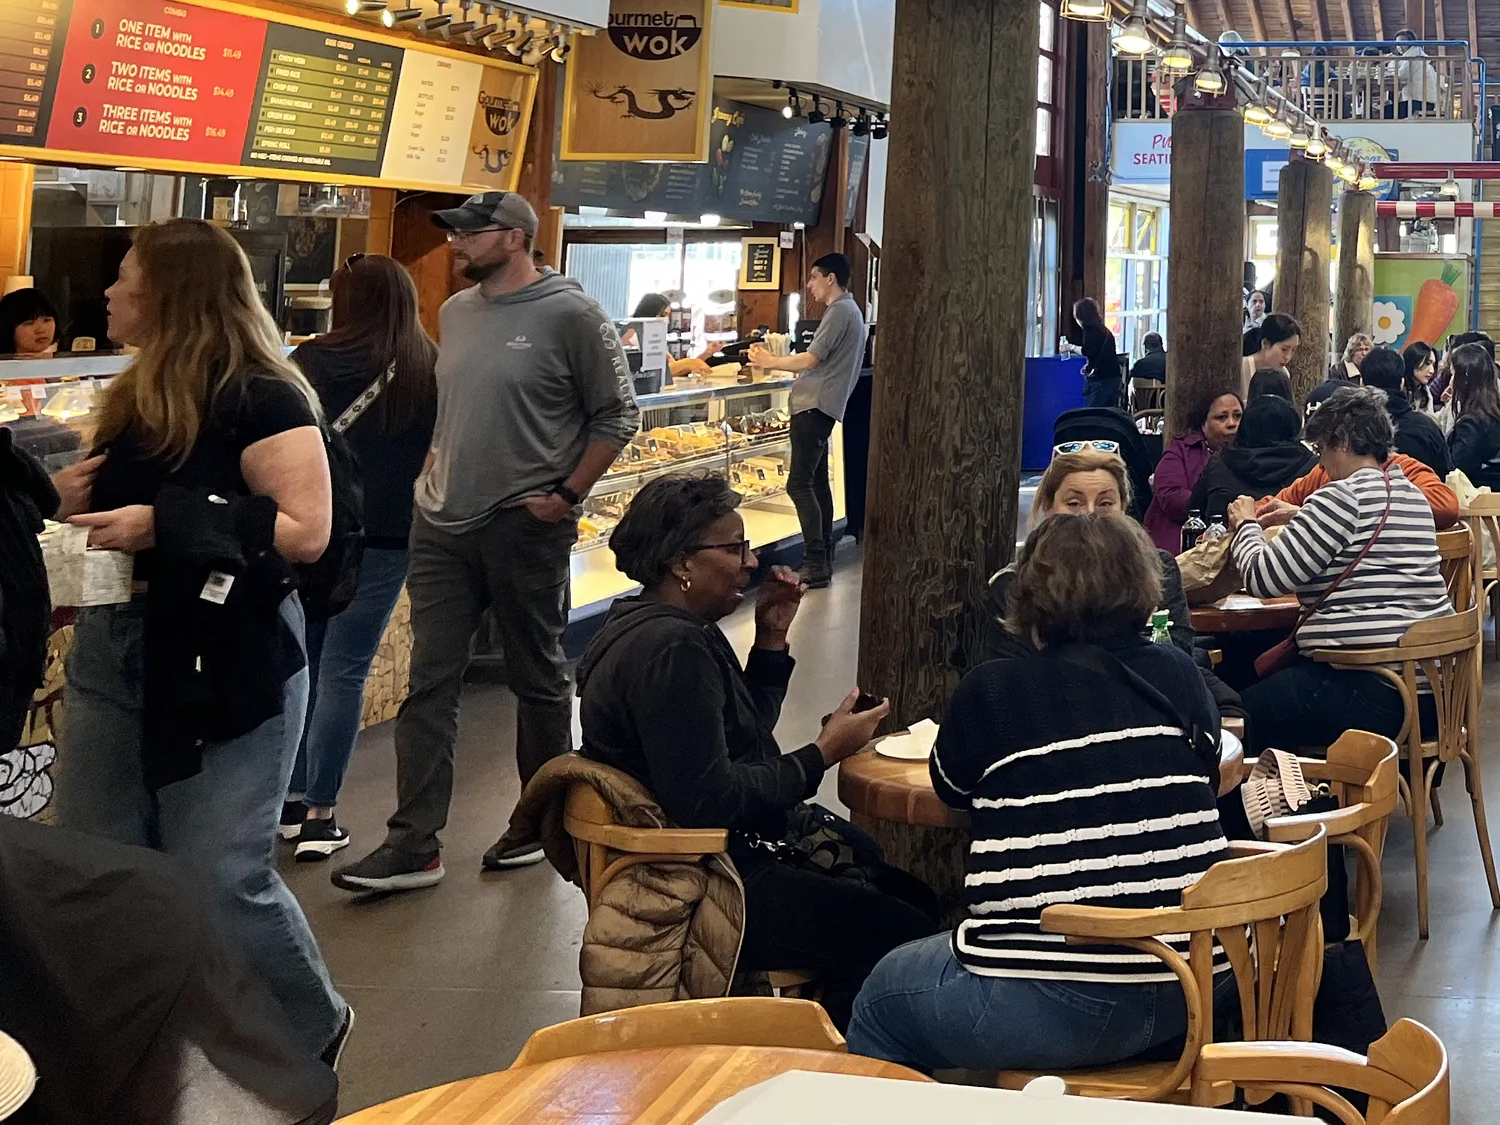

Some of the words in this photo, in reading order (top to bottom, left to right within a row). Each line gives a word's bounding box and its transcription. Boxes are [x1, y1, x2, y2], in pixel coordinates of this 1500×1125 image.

[608, 11, 674, 26] ourmet
[119, 19, 144, 35] ONE
[144, 23, 172, 40] ITEM
[172, 32, 192, 44] WITH
[623, 30, 688, 55] wok
[116, 34, 143, 50] RICE
[143, 42, 155, 52] OR
[155, 41, 207, 61] NOODLES
[222, 47, 242, 60] $11.49
[111, 61, 138, 77] TWO
[139, 66, 172, 83] ITEMS
[172, 74, 193, 85] WITH
[107, 77, 134, 93] RICE
[134, 84, 147, 94] OR
[147, 83, 198, 101] NOODLES
[212, 86, 235, 98] $14.49
[102, 103, 139, 120] THREE
[139, 109, 172, 125] ITEMS
[172, 116, 193, 127] WITH
[489, 113, 514, 133] wok
[99, 119, 125, 135] RICE
[126, 126, 138, 136] OR
[139, 125, 190, 142] NOODLES
[204, 126, 227, 138] $16.49
[1133, 153, 1172, 165] SEATI
